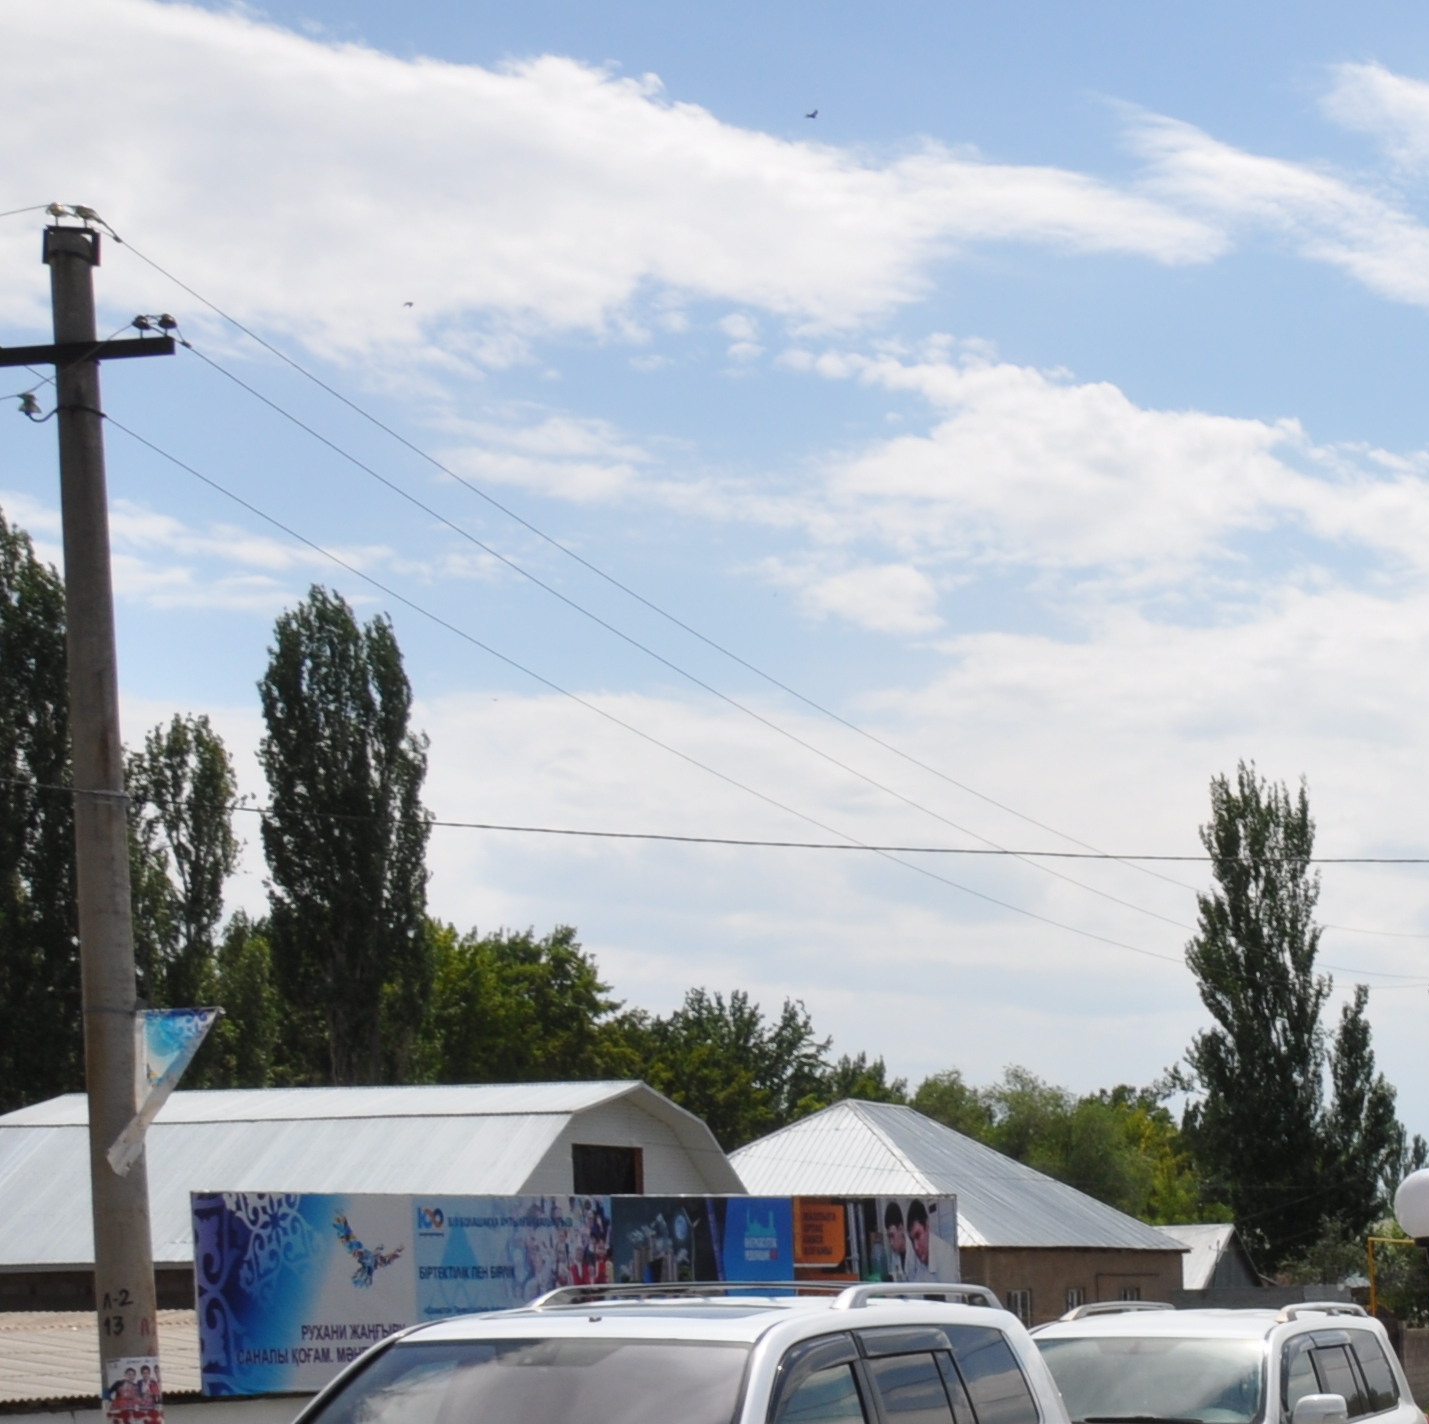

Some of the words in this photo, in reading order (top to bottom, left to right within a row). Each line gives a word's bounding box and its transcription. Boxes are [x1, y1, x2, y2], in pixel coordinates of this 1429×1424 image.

[104, 1316, 124, 1336] 13
[301, 1325, 347, 1341] РУХАНИ
[237, 1348, 288, 1365] САНАЛЫ
